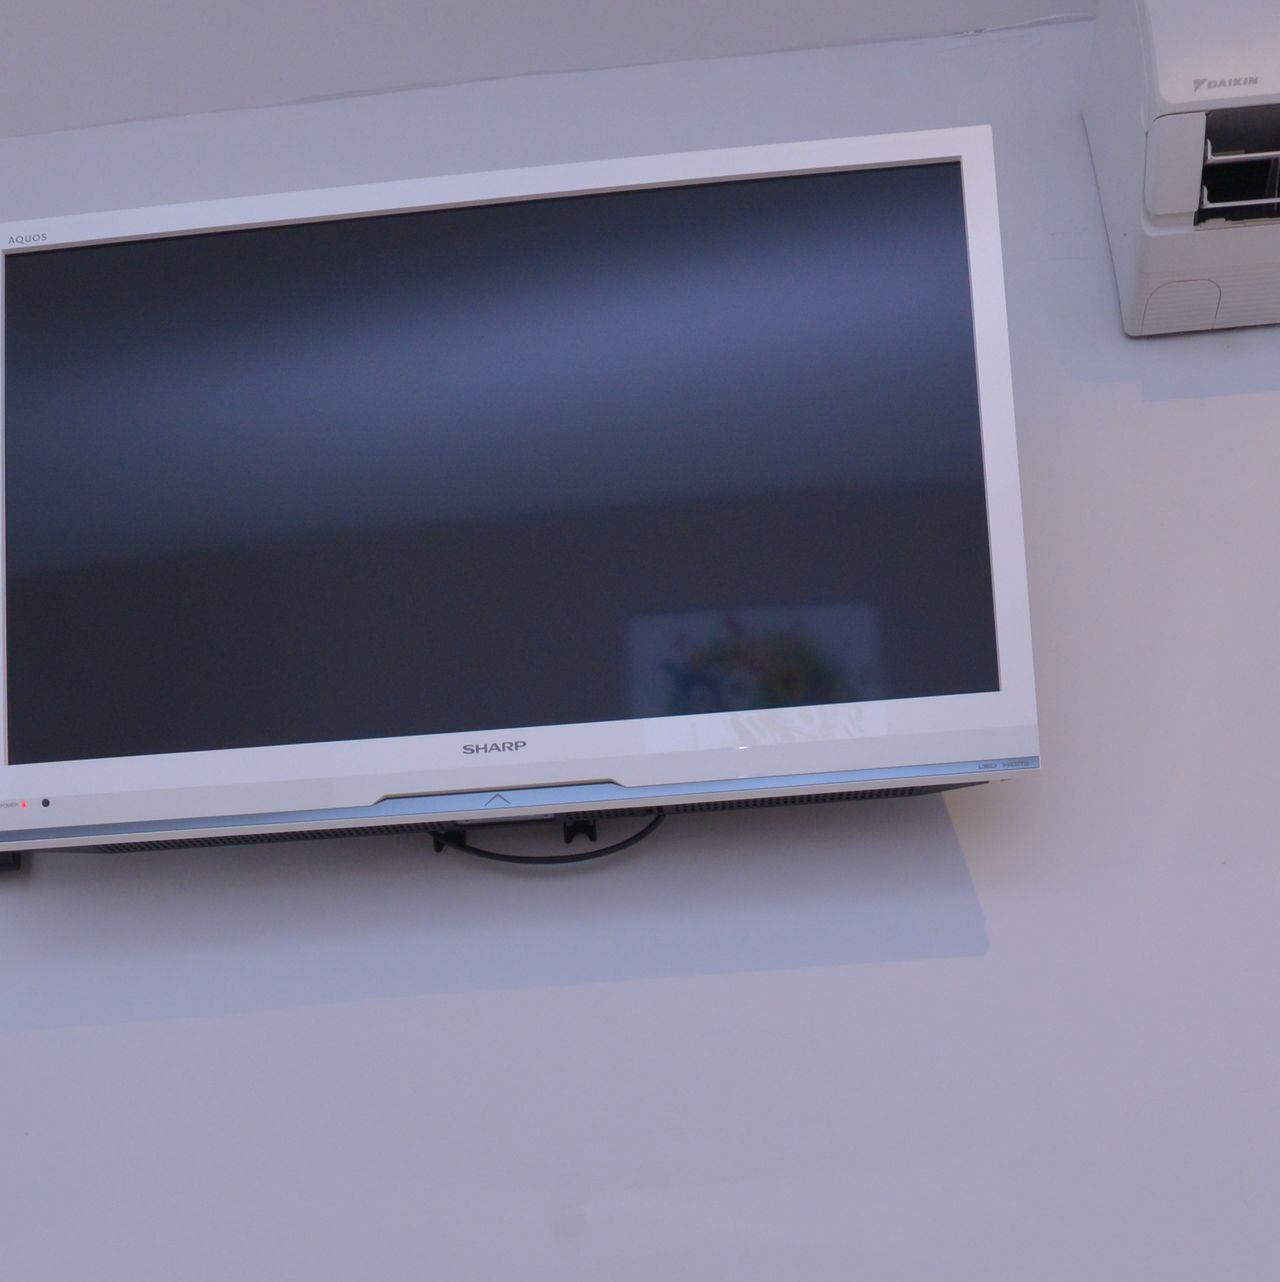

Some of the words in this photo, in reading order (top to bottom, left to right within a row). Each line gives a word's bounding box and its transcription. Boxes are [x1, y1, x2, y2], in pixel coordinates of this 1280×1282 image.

[1207, 77, 1259, 89] DAIKIN
[8, 233, 48, 245] AQUOS
[462, 740, 527, 755] SHARP
